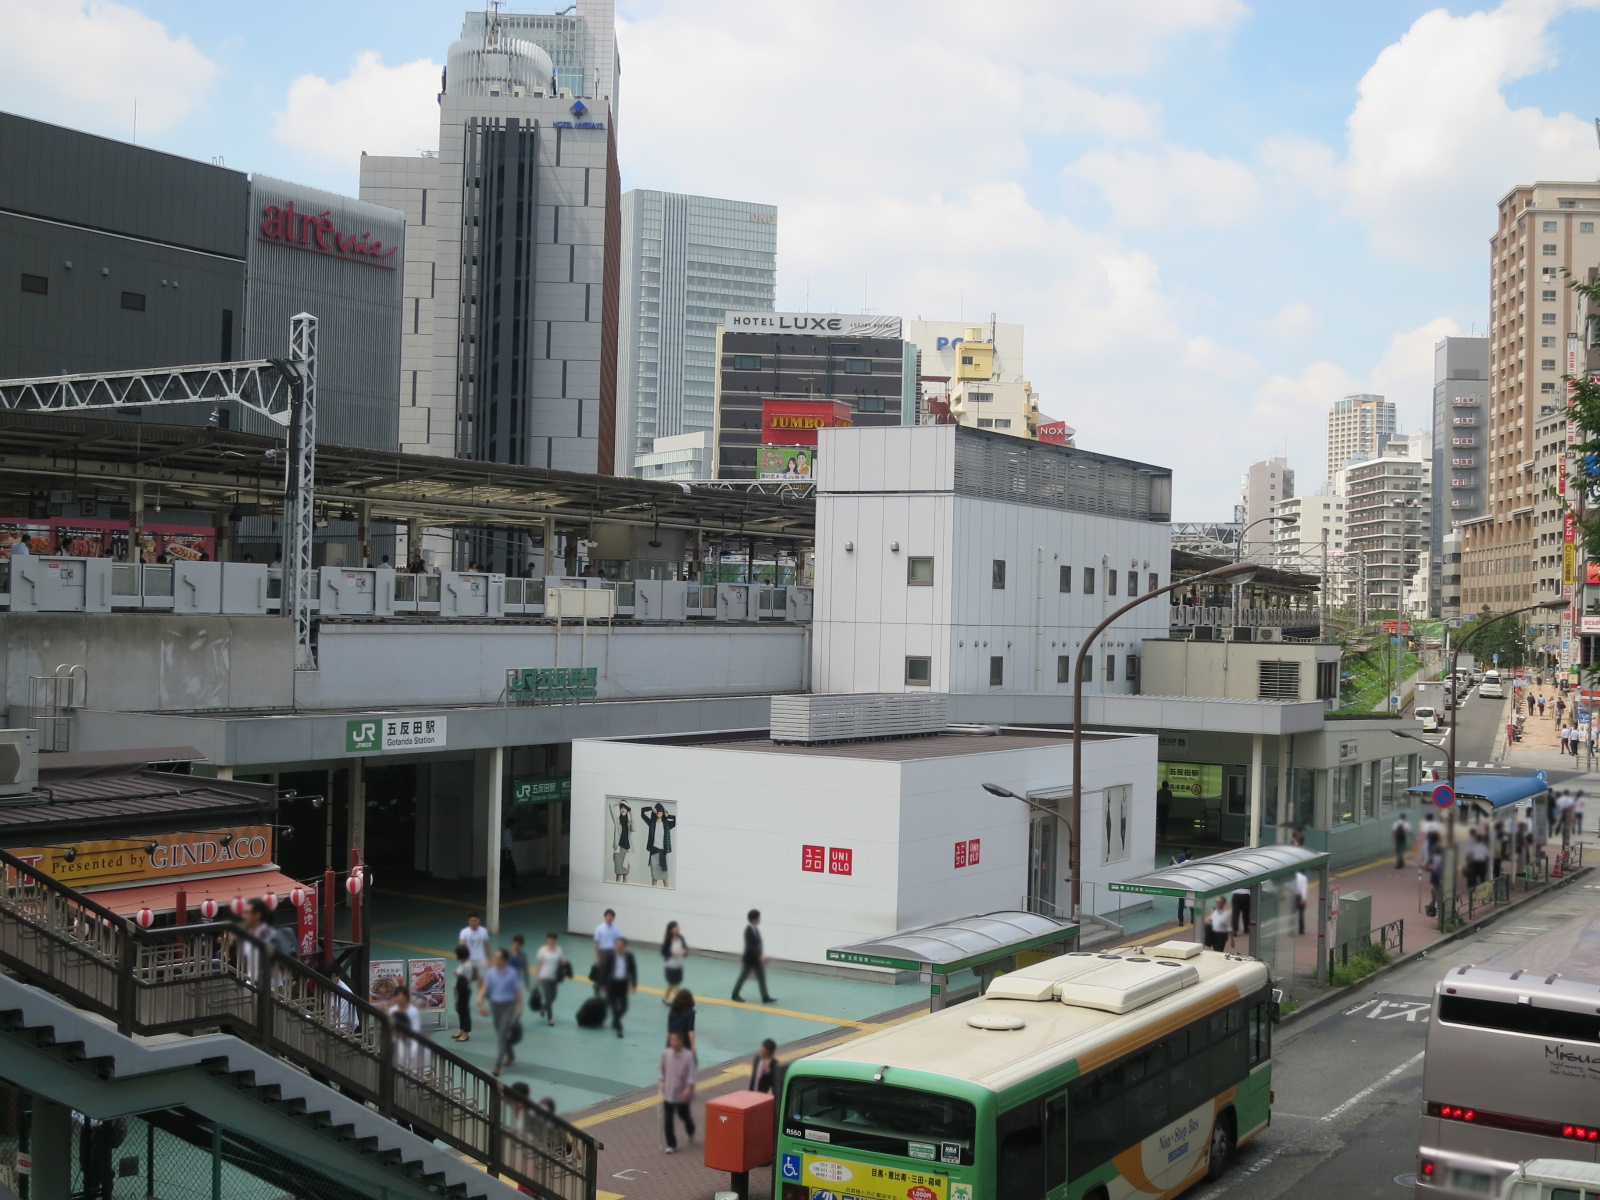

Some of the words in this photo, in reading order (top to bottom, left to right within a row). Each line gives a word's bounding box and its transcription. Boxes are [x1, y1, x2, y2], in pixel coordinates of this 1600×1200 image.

[733, 317, 775, 326] HOTEL
[779, 316, 842, 331] LUXE
[770, 415, 825, 428] JUMBO
[1040, 427, 1064, 435] NOX
[512, 669, 537, 690] JR
[352, 723, 376, 742] JR
[387, 721, 435, 736] 五反田駅
[387, 738, 413, 747] Gotanda
[414, 736, 435, 745] Station
[1170, 769, 1199, 777] 五反田駅
[1536, 772, 1543, 780] 4
[516, 785, 531, 798] JR
[532, 783, 556, 794] 五反田駅
[52, 857, 123, 874] Presented
[130, 854, 146, 868] by
[150, 836, 267, 869] GINDACO
[832, 851, 848, 861] UNI
[1343, 1000, 1431, 1022] バス
